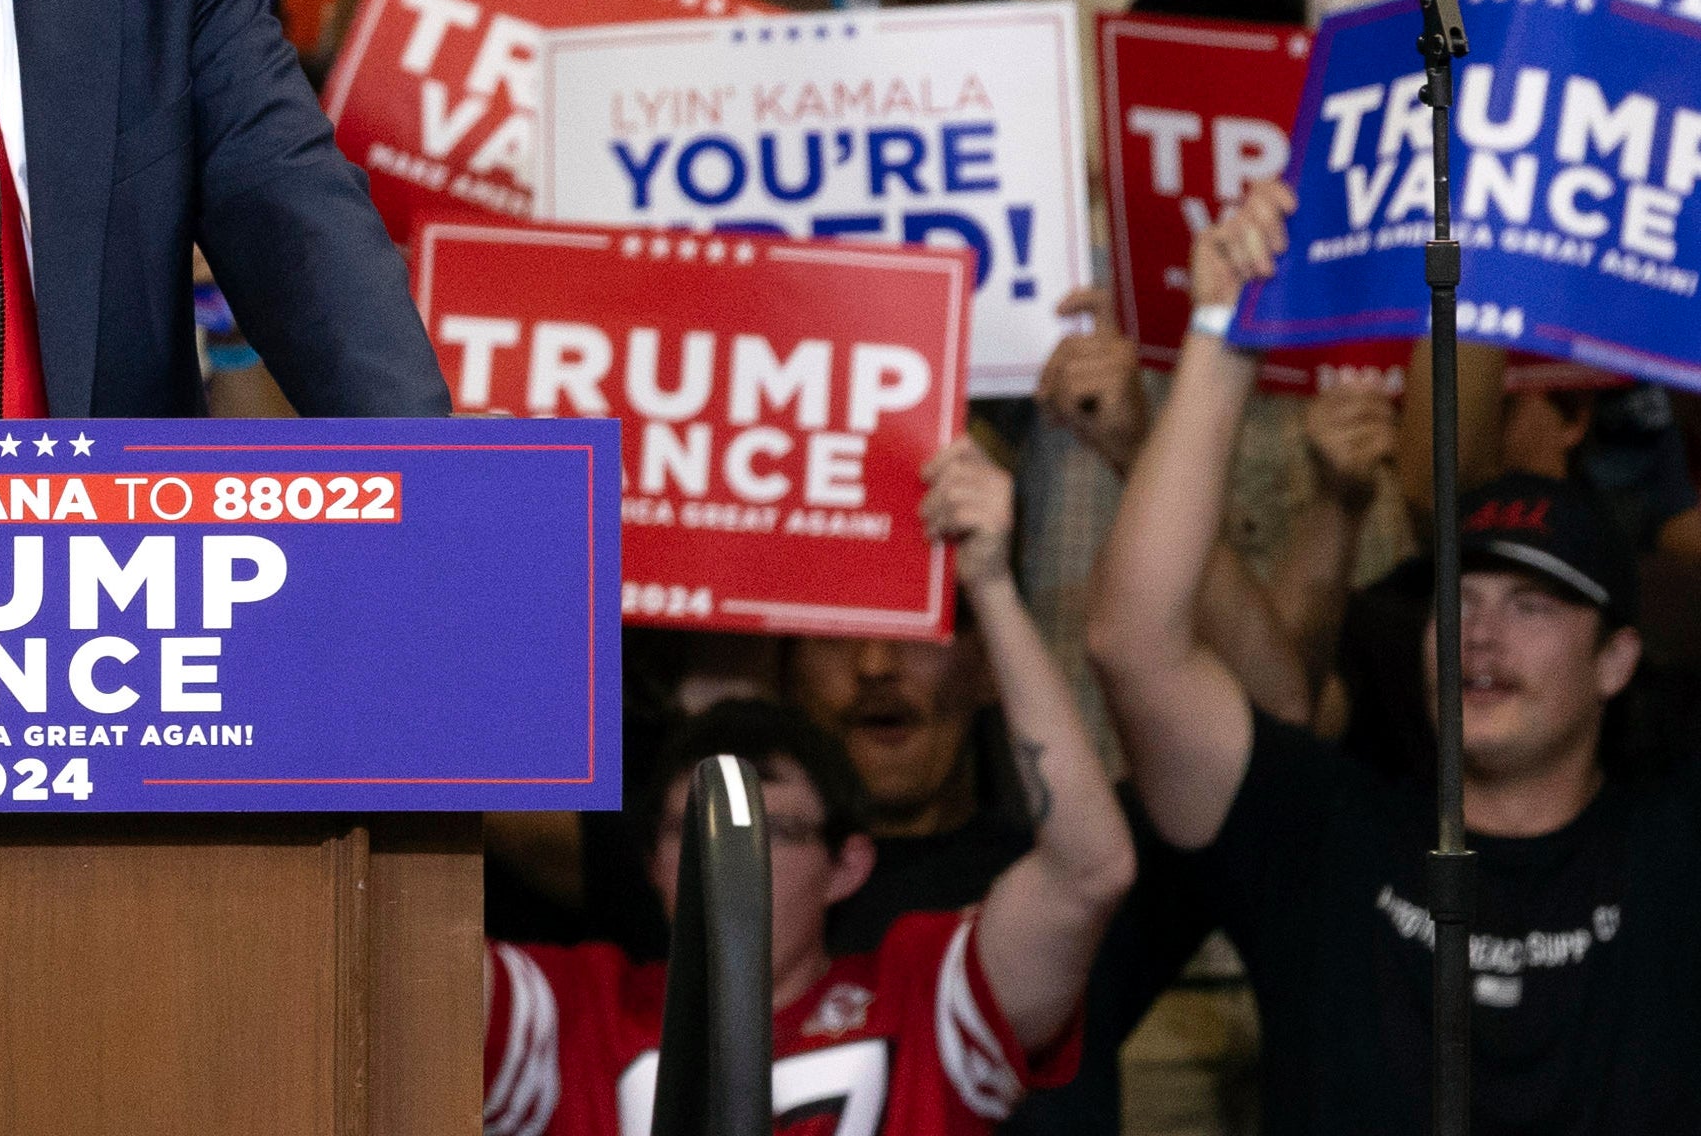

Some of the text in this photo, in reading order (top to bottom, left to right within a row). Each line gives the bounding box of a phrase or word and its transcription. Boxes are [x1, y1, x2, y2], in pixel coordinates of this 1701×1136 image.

[752, 72, 994, 123] KAMALA
[609, 118, 1002, 210] YOU'RE
[1344, 149, 1684, 262] VANCE
[438, 314, 932, 433] TRUMP
[114, 476, 193, 522] TO
[213, 476, 396, 522] 88022
[626, 423, 869, 508] NCE
[23, 724, 129, 748] GREAT
[140, 724, 253, 748] AGAIN!
